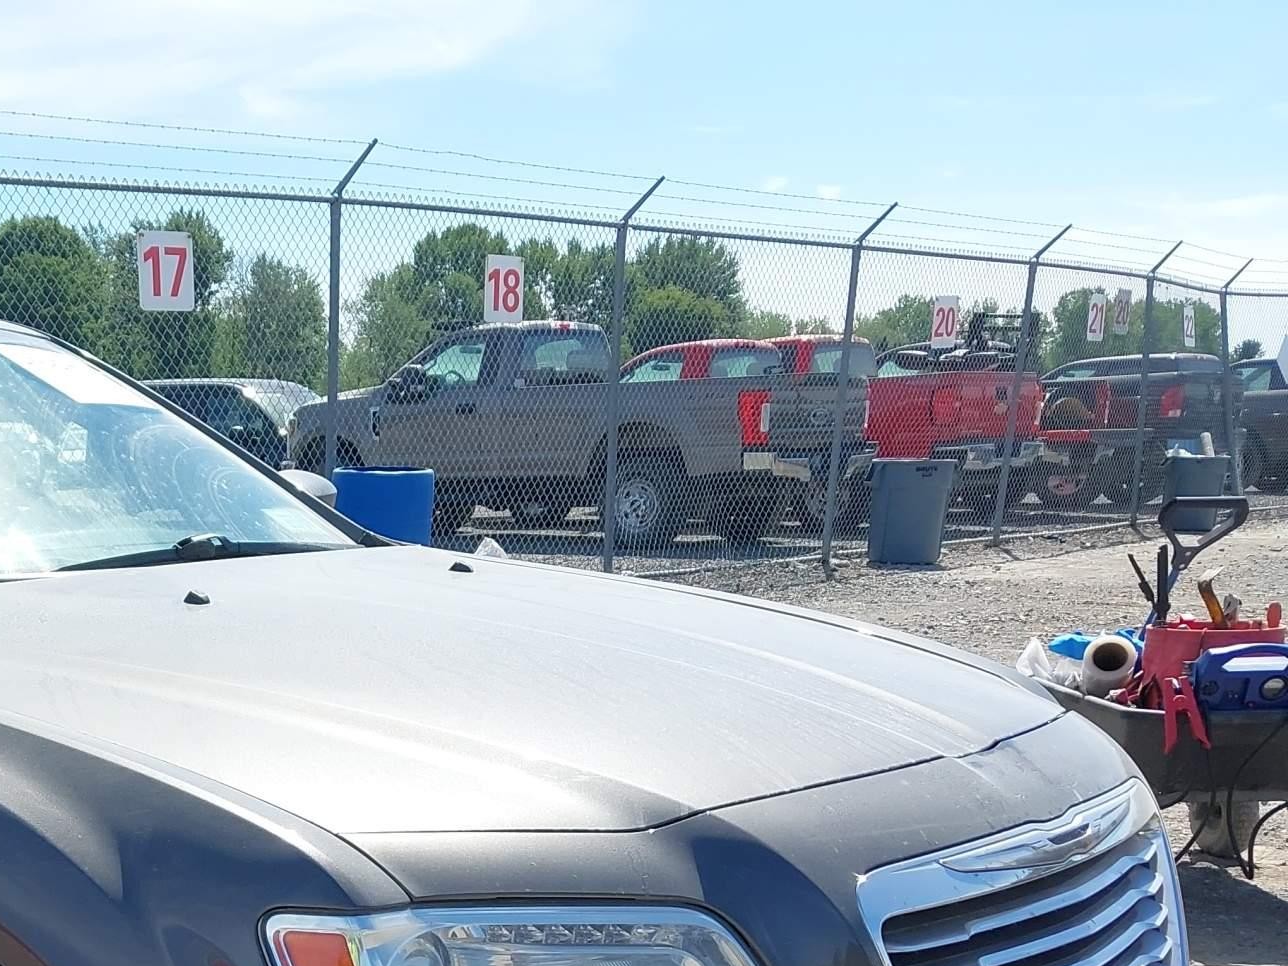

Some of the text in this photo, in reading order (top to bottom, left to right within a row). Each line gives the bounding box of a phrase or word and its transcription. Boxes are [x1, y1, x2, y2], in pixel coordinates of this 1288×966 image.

[143, 245, 187, 297] 17
[488, 268, 520, 313] 18
[934, 306, 956, 338] 20
[1089, 302, 1104, 334] 21
